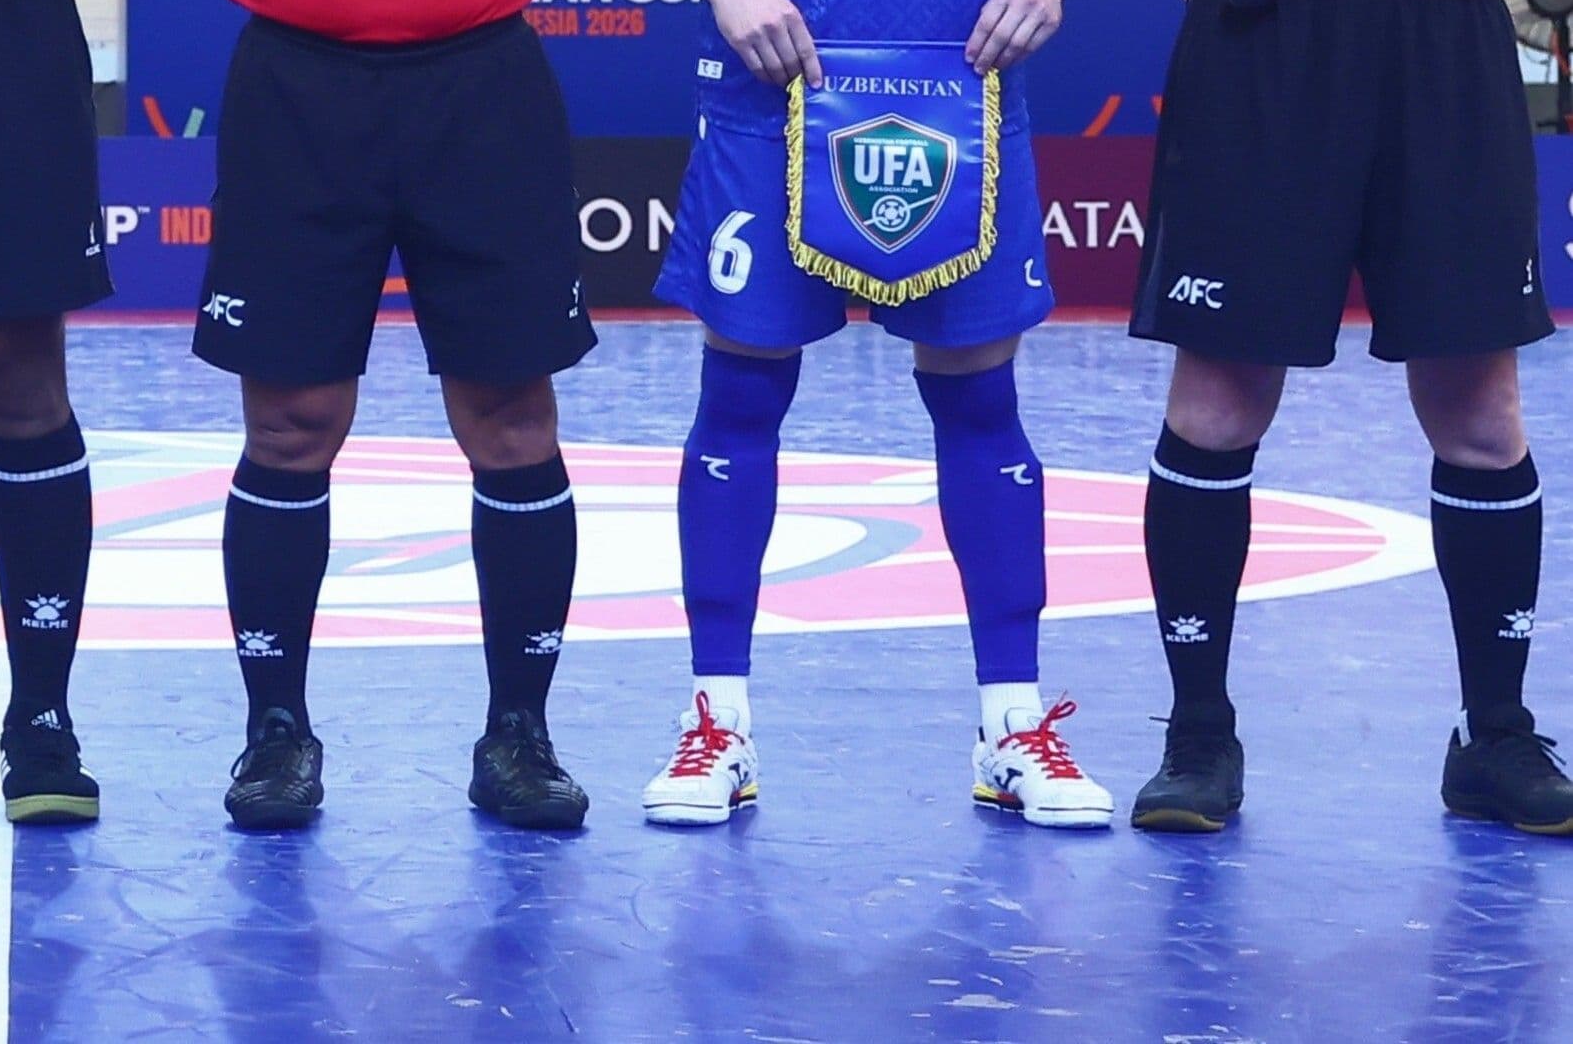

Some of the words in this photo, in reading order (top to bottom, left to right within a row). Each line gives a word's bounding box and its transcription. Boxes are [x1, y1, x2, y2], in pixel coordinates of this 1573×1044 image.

[586, 9, 645, 36] 2026
[824, 75, 963, 96] UZBEKISTAN
[854, 144, 933, 187] UFA
[708, 210, 755, 294] 6
[1168, 275, 1224, 309] AFC
[21, 617, 69, 629] KELME
[1165, 633, 1209, 643] KELME
